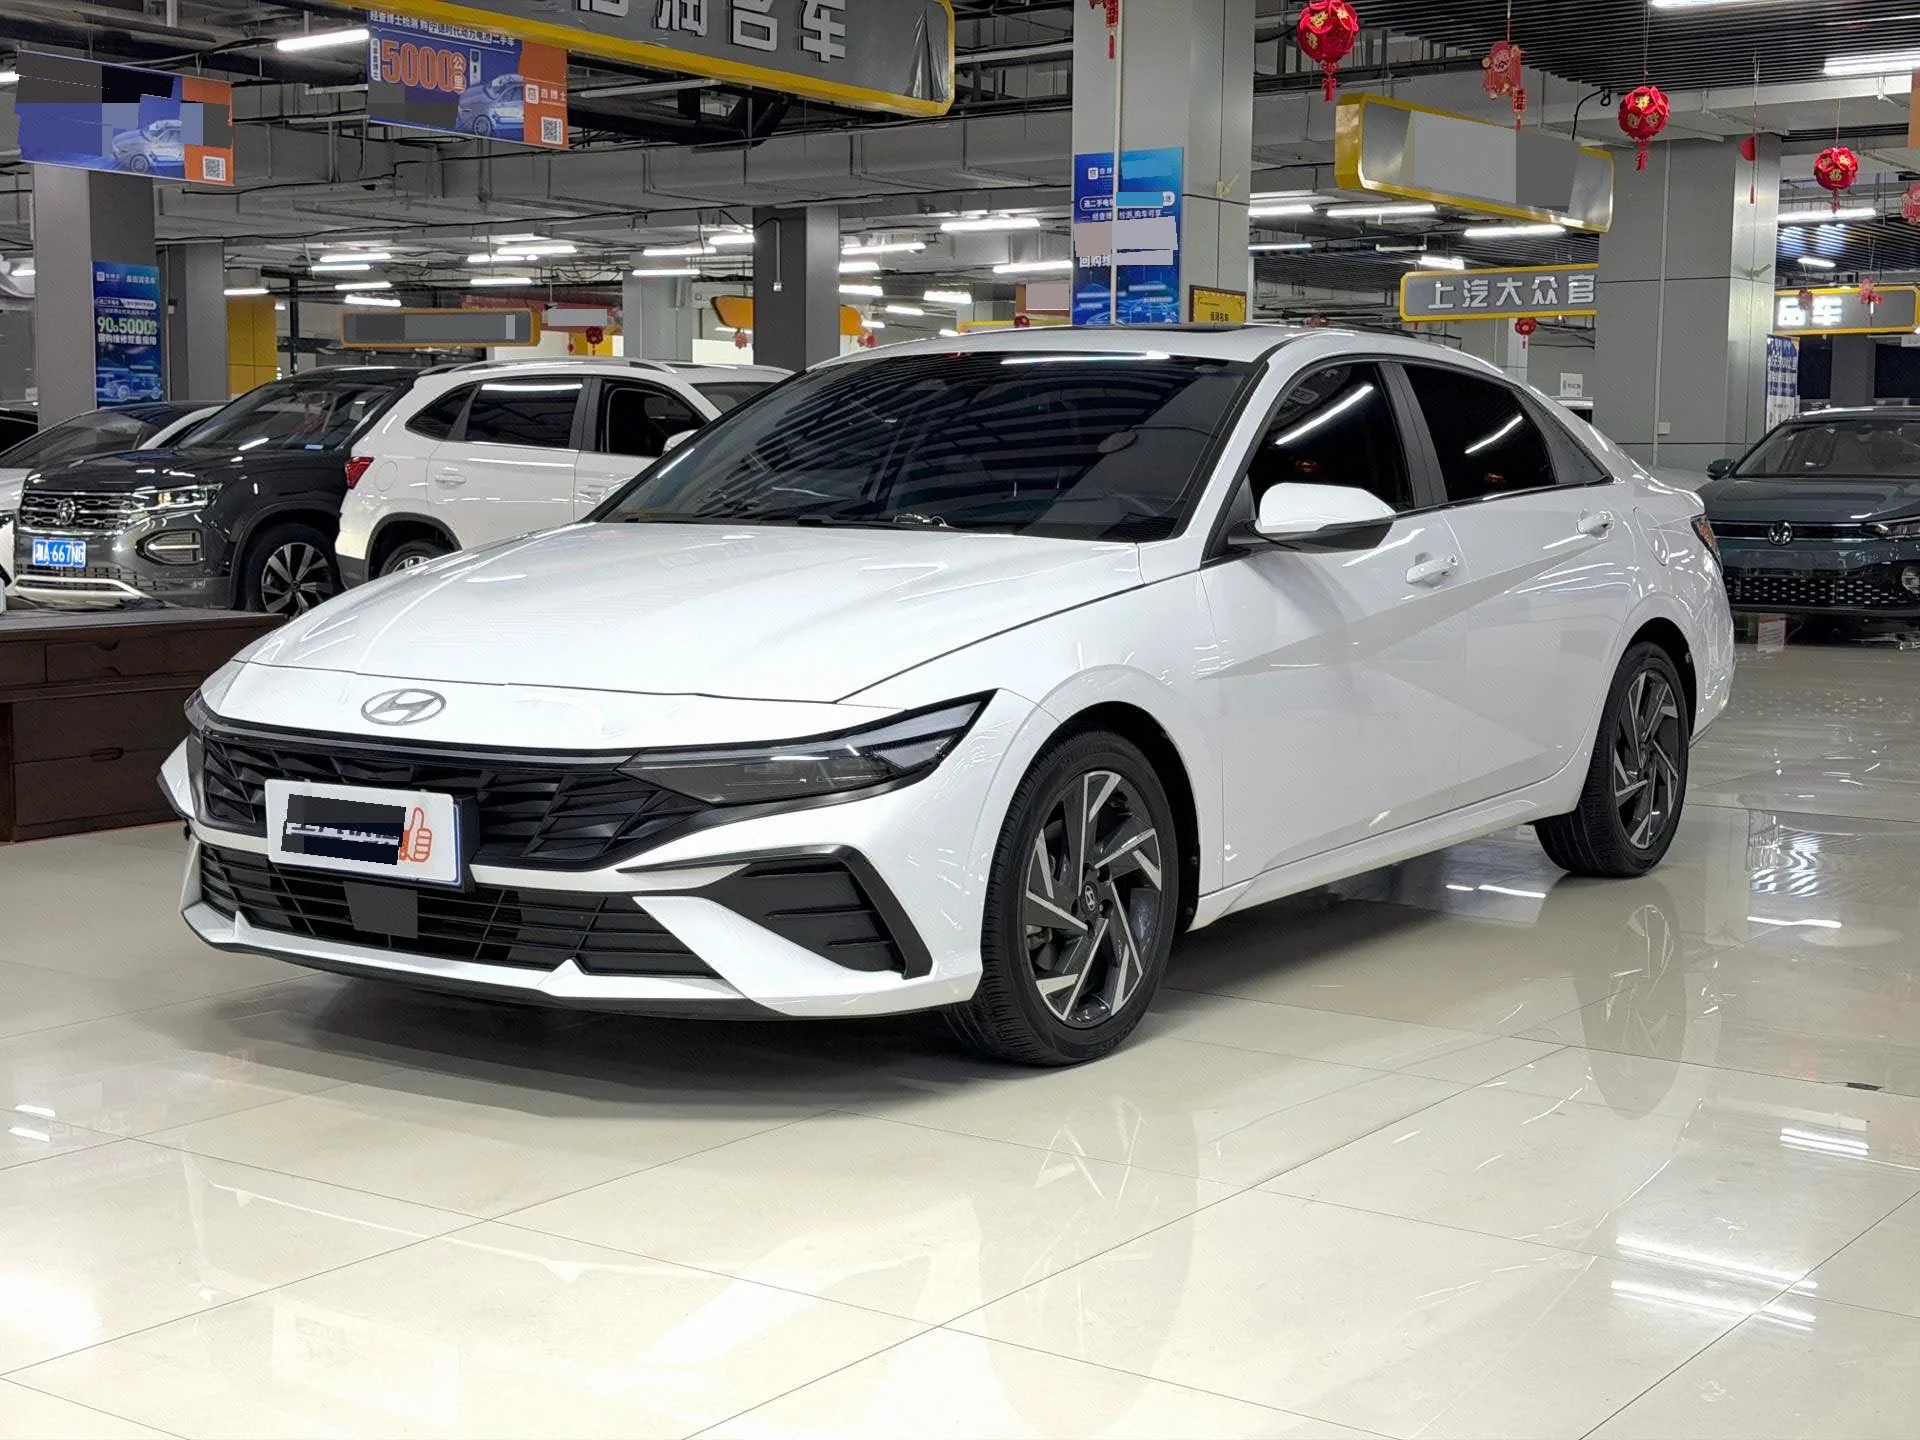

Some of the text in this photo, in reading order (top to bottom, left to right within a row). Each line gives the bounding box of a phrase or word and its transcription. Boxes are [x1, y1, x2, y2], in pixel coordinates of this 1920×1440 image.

[1427, 274, 1596, 310] 上汽大众官
